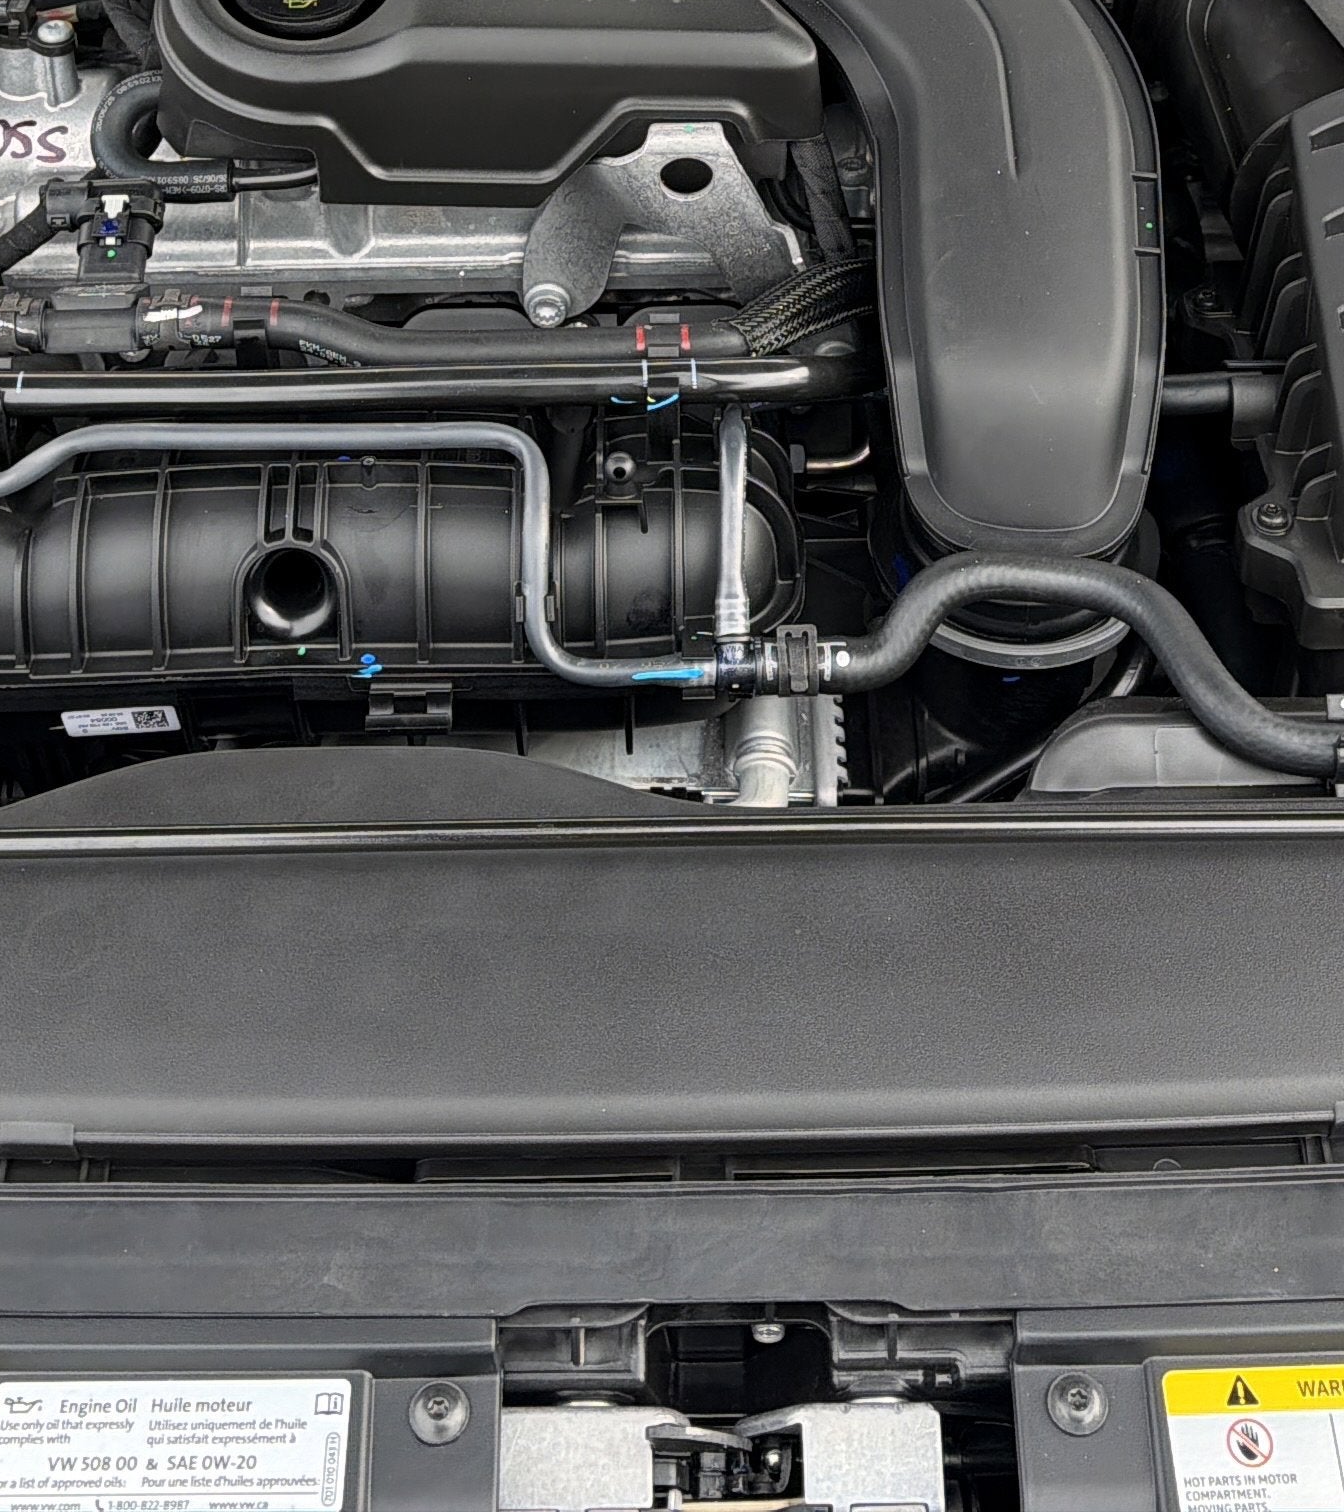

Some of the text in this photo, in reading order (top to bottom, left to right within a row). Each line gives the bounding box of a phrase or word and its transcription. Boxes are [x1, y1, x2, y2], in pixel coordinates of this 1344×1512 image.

[59, 1397, 252, 1418] Engine Oil Huile moteur
[0, 1418, 134, 1434] Use only oil that expressly
[148, 1418, 308, 1433] Utilisez uniquement de l'huile
[46, 1434, 71, 1445] with
[146, 1433, 287, 1448] qui satisfait expressément
[48, 1455, 257, 1472] VW 508 00 & SAE 0W-20
[19, 1477, 36, 1489] list
[37, 1477, 51, 1489] of
[50, 1477, 102, 1491] approved
[141, 1476, 166, 1488] Pour
[168, 1478, 189, 1488] une
[190, 1476, 213, 1488] liste
[214, 1475, 254, 1488] d'huiles
[1184, 1473, 1298, 1487] HOT PARTS IN MOTOR
[1186, 1487, 1272, 1502] COMPARTMENT.
[1187, 1502, 1272, 1512] MOVING PARTS.
